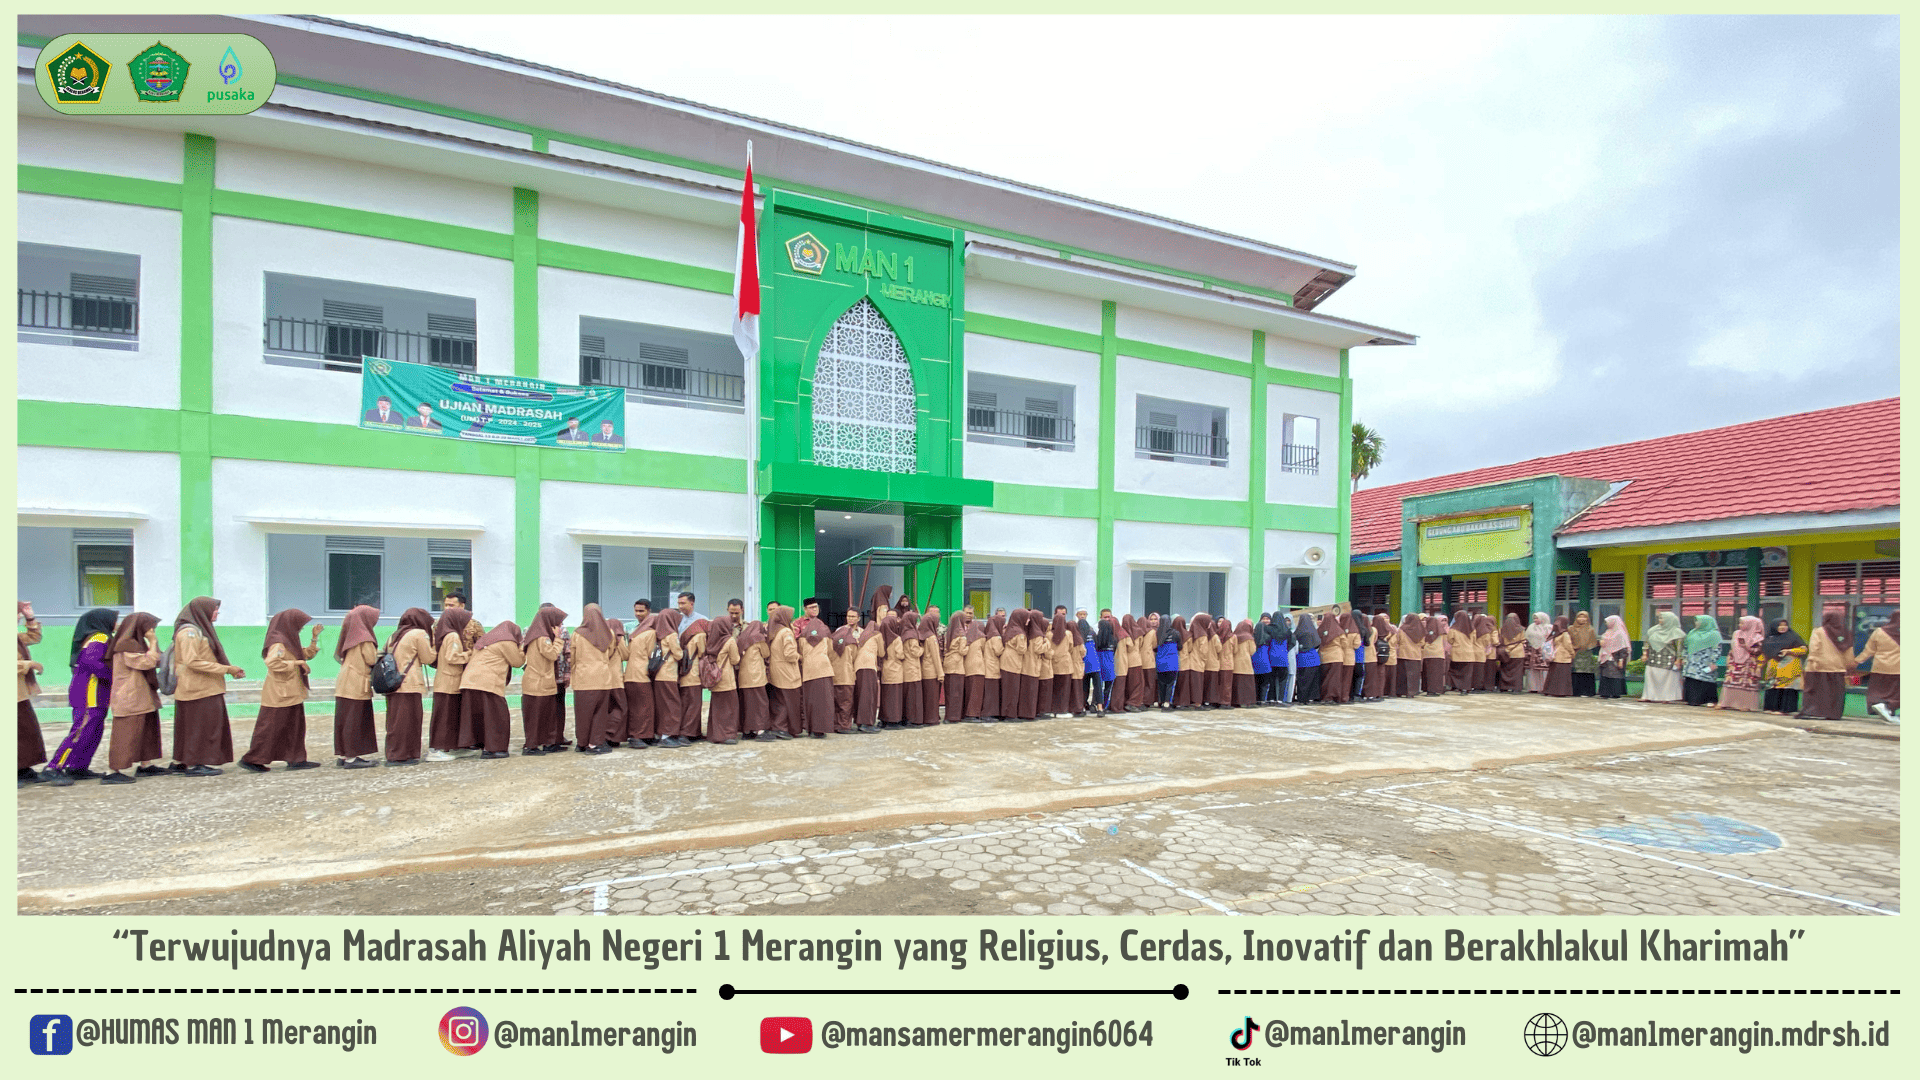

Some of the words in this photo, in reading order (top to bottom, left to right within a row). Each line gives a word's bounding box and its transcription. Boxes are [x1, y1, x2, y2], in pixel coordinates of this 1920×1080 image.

[835, 242, 898, 281] MAN
[904, 255, 914, 284] 1
[439, 399, 482, 413] UJIAN
[484, 403, 563, 421] MADRASAH
